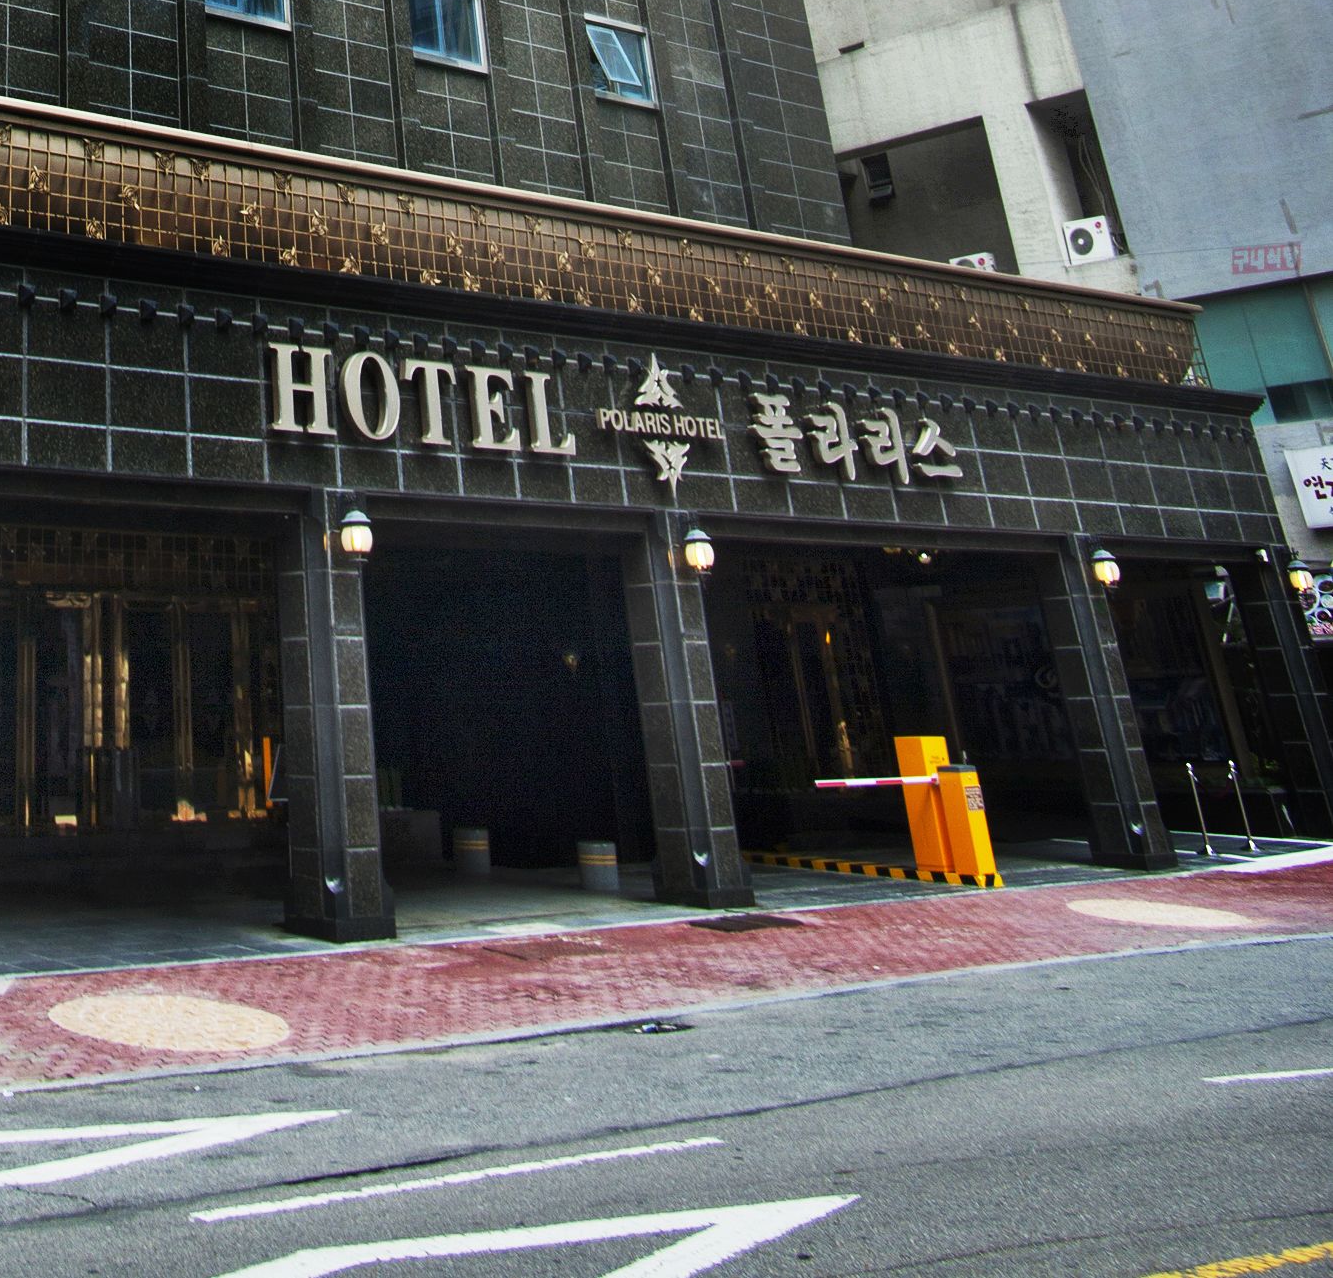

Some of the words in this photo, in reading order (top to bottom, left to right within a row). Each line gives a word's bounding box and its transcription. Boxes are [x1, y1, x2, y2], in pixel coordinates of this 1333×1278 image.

[268, 341, 577, 456] HOTEL
[596, 407, 672, 436] POLARIS
[673, 414, 727, 440] HOTEL
[747, 392, 964, 485] 폴라리스
